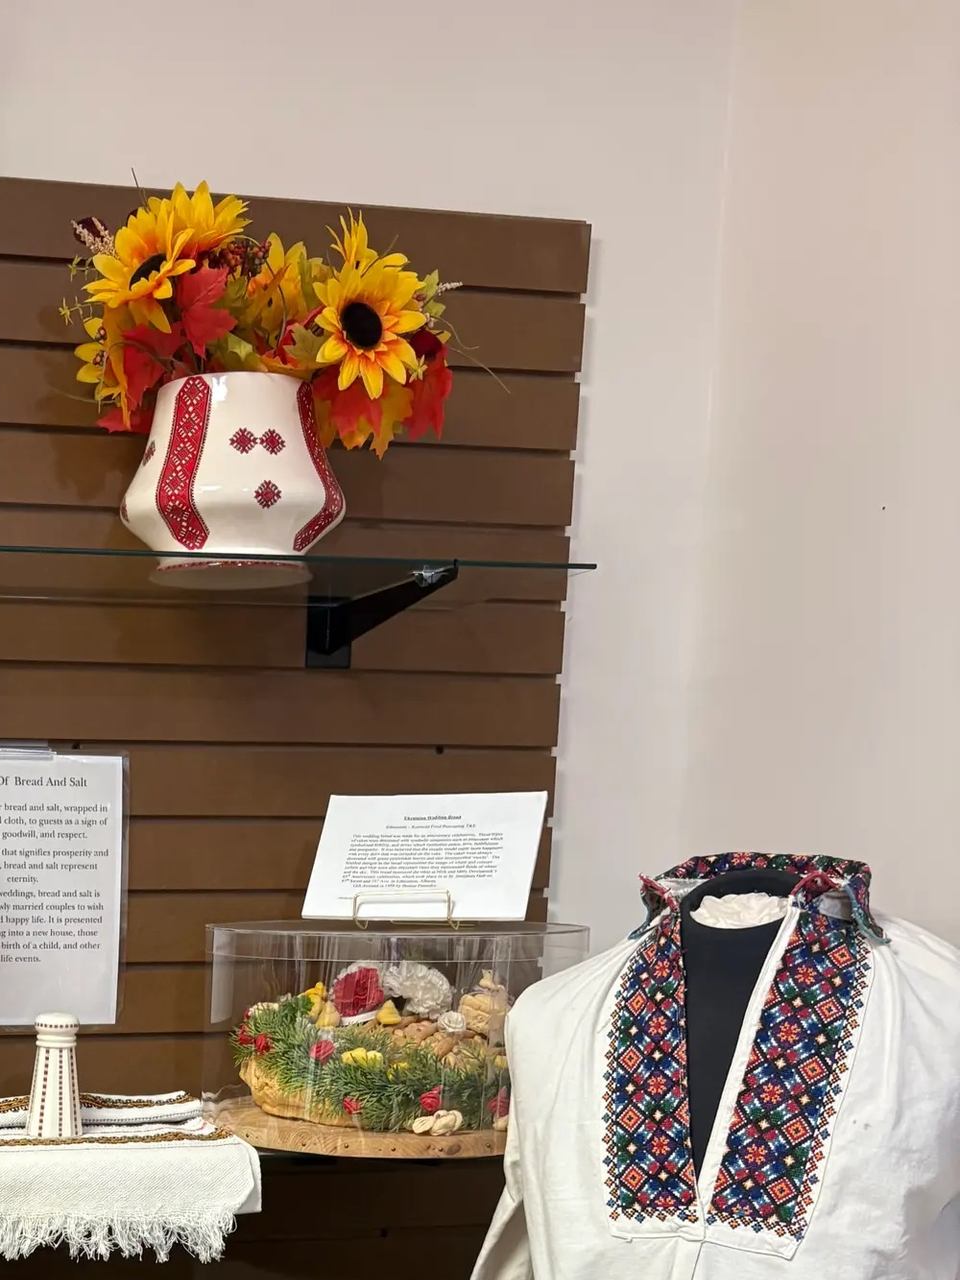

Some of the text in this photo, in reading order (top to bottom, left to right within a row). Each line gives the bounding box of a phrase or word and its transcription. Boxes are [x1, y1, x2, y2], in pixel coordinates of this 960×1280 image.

[14, 776, 44, 787] Bread
[46, 776, 67, 787] And
[69, 777, 87, 787] Salt
[4, 802, 28, 812] bread
[29, 803, 45, 812] and
[46, 803, 62, 815] salt,
[64, 803, 98, 815] wrapped
[99, 804, 108, 813] in
[3, 816, 27, 826] cloth,
[38, 818, 63, 828] guests
[81, 817, 97, 829] sign
[99, 817, 108, 826] of
[2, 829, 39, 840] goodwill,
[39, 830, 56, 839] and
[57, 832, 88, 841] respect.
[1, 848, 18, 856] that
[19, 848, 51, 859] signifies
[52, 848, 93, 859] prosperity
[93, 848, 109, 857] and
[3, 860, 27, 870] bread
[28, 861, 44, 870] and
[45, 861, 59, 870] salt
[60, 863, 98, 872] represent
[6, 874, 39, 885] eternity.
[38, 889, 61, 898] bread
[62, 889, 78, 898] and
[79, 889, 93, 898] salt
[94, 889, 101, 898] is
[12, 902, 44, 911] married
[45, 902, 76, 914] couples
[87, 902, 104, 911] wish
[5, 915, 30, 926] happy
[31, 915, 47, 924] life.
[48, 914, 55, 924] It
[56, 916, 63, 924] is
[64, 914, 103, 926] presented
[8, 928, 24, 937] into
[50, 928, 76, 938] house,
[77, 928, 99, 937] those
[1, 941, 21, 952] birth
[22, 941, 31, 949] of
[39, 941, 61, 950] child,
[63, 941, 78, 950] and
[79, 941, 101, 950] other
[0, 954, 42, 965] life events.
